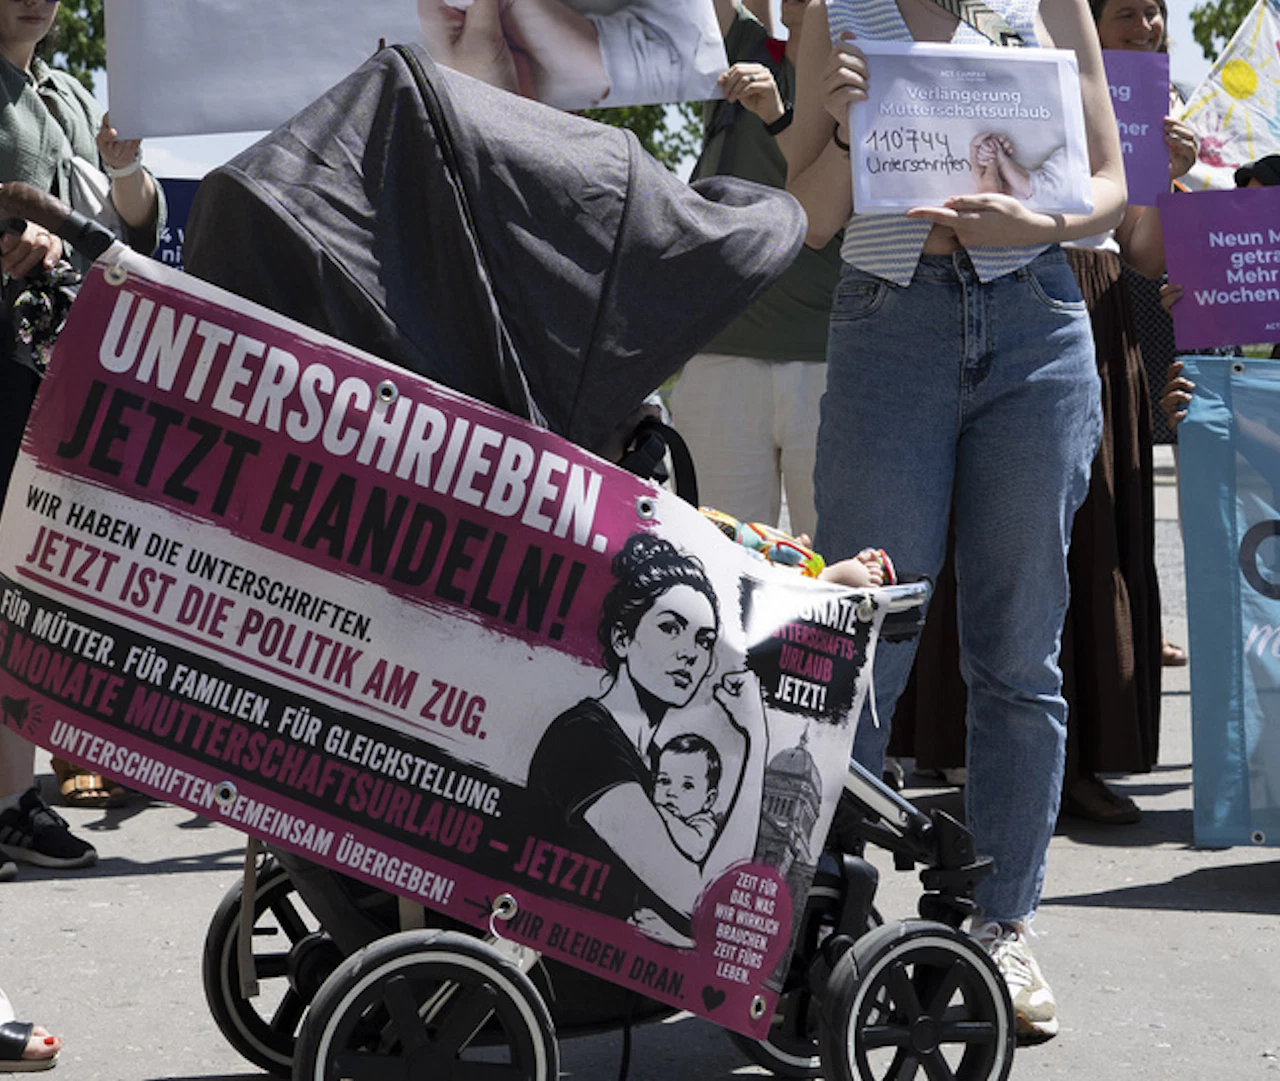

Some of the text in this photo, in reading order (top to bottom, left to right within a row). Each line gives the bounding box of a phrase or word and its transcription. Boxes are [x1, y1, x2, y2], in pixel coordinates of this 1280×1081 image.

[879, 102, 1052, 120] Mutterschaftsurlaub
[907, 86, 1022, 104] Verlängerung
[1209, 231, 1264, 248] Neun
[1226, 266, 1279, 285] Mehr
[1194, 285, 1280, 306] Wochen
[99, 290, 608, 552] UNTERSCHRIEBEN.
[56, 379, 586, 641] JETZT HANDELN!
[25, 484, 372, 642] WIR HABEN DIE UNTERSCHRIFTEN.
[25, 525, 487, 740] JETZT IST DIE POLITIK AM ZUG.
[773, 622, 859, 660] UTTERSCHAFTS-
[779, 643, 834, 682] URLAUB
[0, 589, 502, 817] FÜR MÜTTER. FÜR FAMILIEN. FÜR GLEICHSTELLUNG.
[774, 674, 828, 712] JETZT!
[8, 633, 125, 717] MONATE
[124, 685, 484, 854] MUTTERSCHAFTSURLAUB
[514, 836, 610, 900] JETZT!
[50, 720, 218, 810] UNTERSCHRIFTEN
[335, 833, 455, 905] ÜBERGEBEN!
[736, 871, 778, 898] ZEIT FÜR
[714, 902, 780, 936] WIR WIRKLICH
[754, 896, 776, 916] WAS
[506, 909, 685, 1000] WIR BLEIBEN DRAN.
[713, 940, 763, 969] ZEIT FÜRS
[715, 922, 768, 952] BRAUCHEN.
[716, 961, 750, 985] LEBEN.
